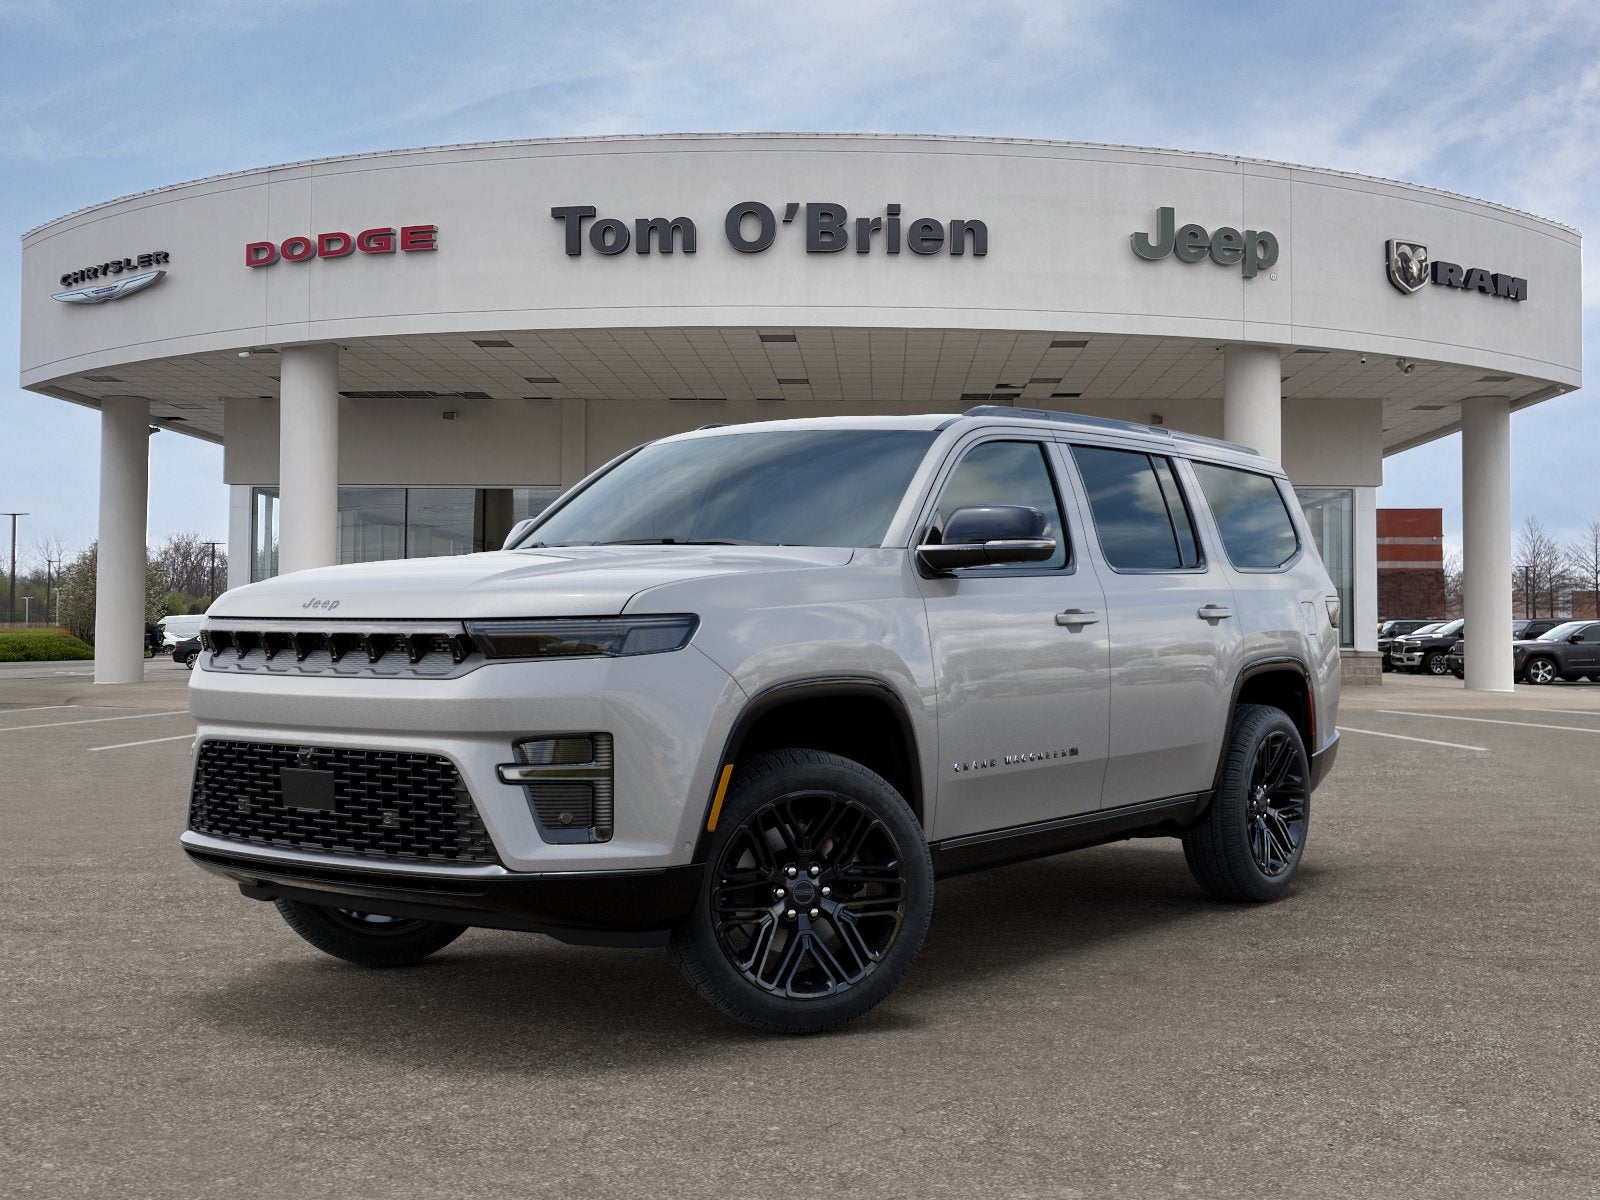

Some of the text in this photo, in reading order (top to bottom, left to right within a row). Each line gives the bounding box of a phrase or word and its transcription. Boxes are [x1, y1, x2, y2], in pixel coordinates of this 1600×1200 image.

[245, 224, 439, 268] DODGE
[551, 201, 989, 257] Tom O'Brien
[1130, 206, 1280, 279] Jeep
[60, 250, 170, 287] CHRYSLER
[1430, 260, 1529, 302] RAM
[302, 597, 341, 611] Jeep
